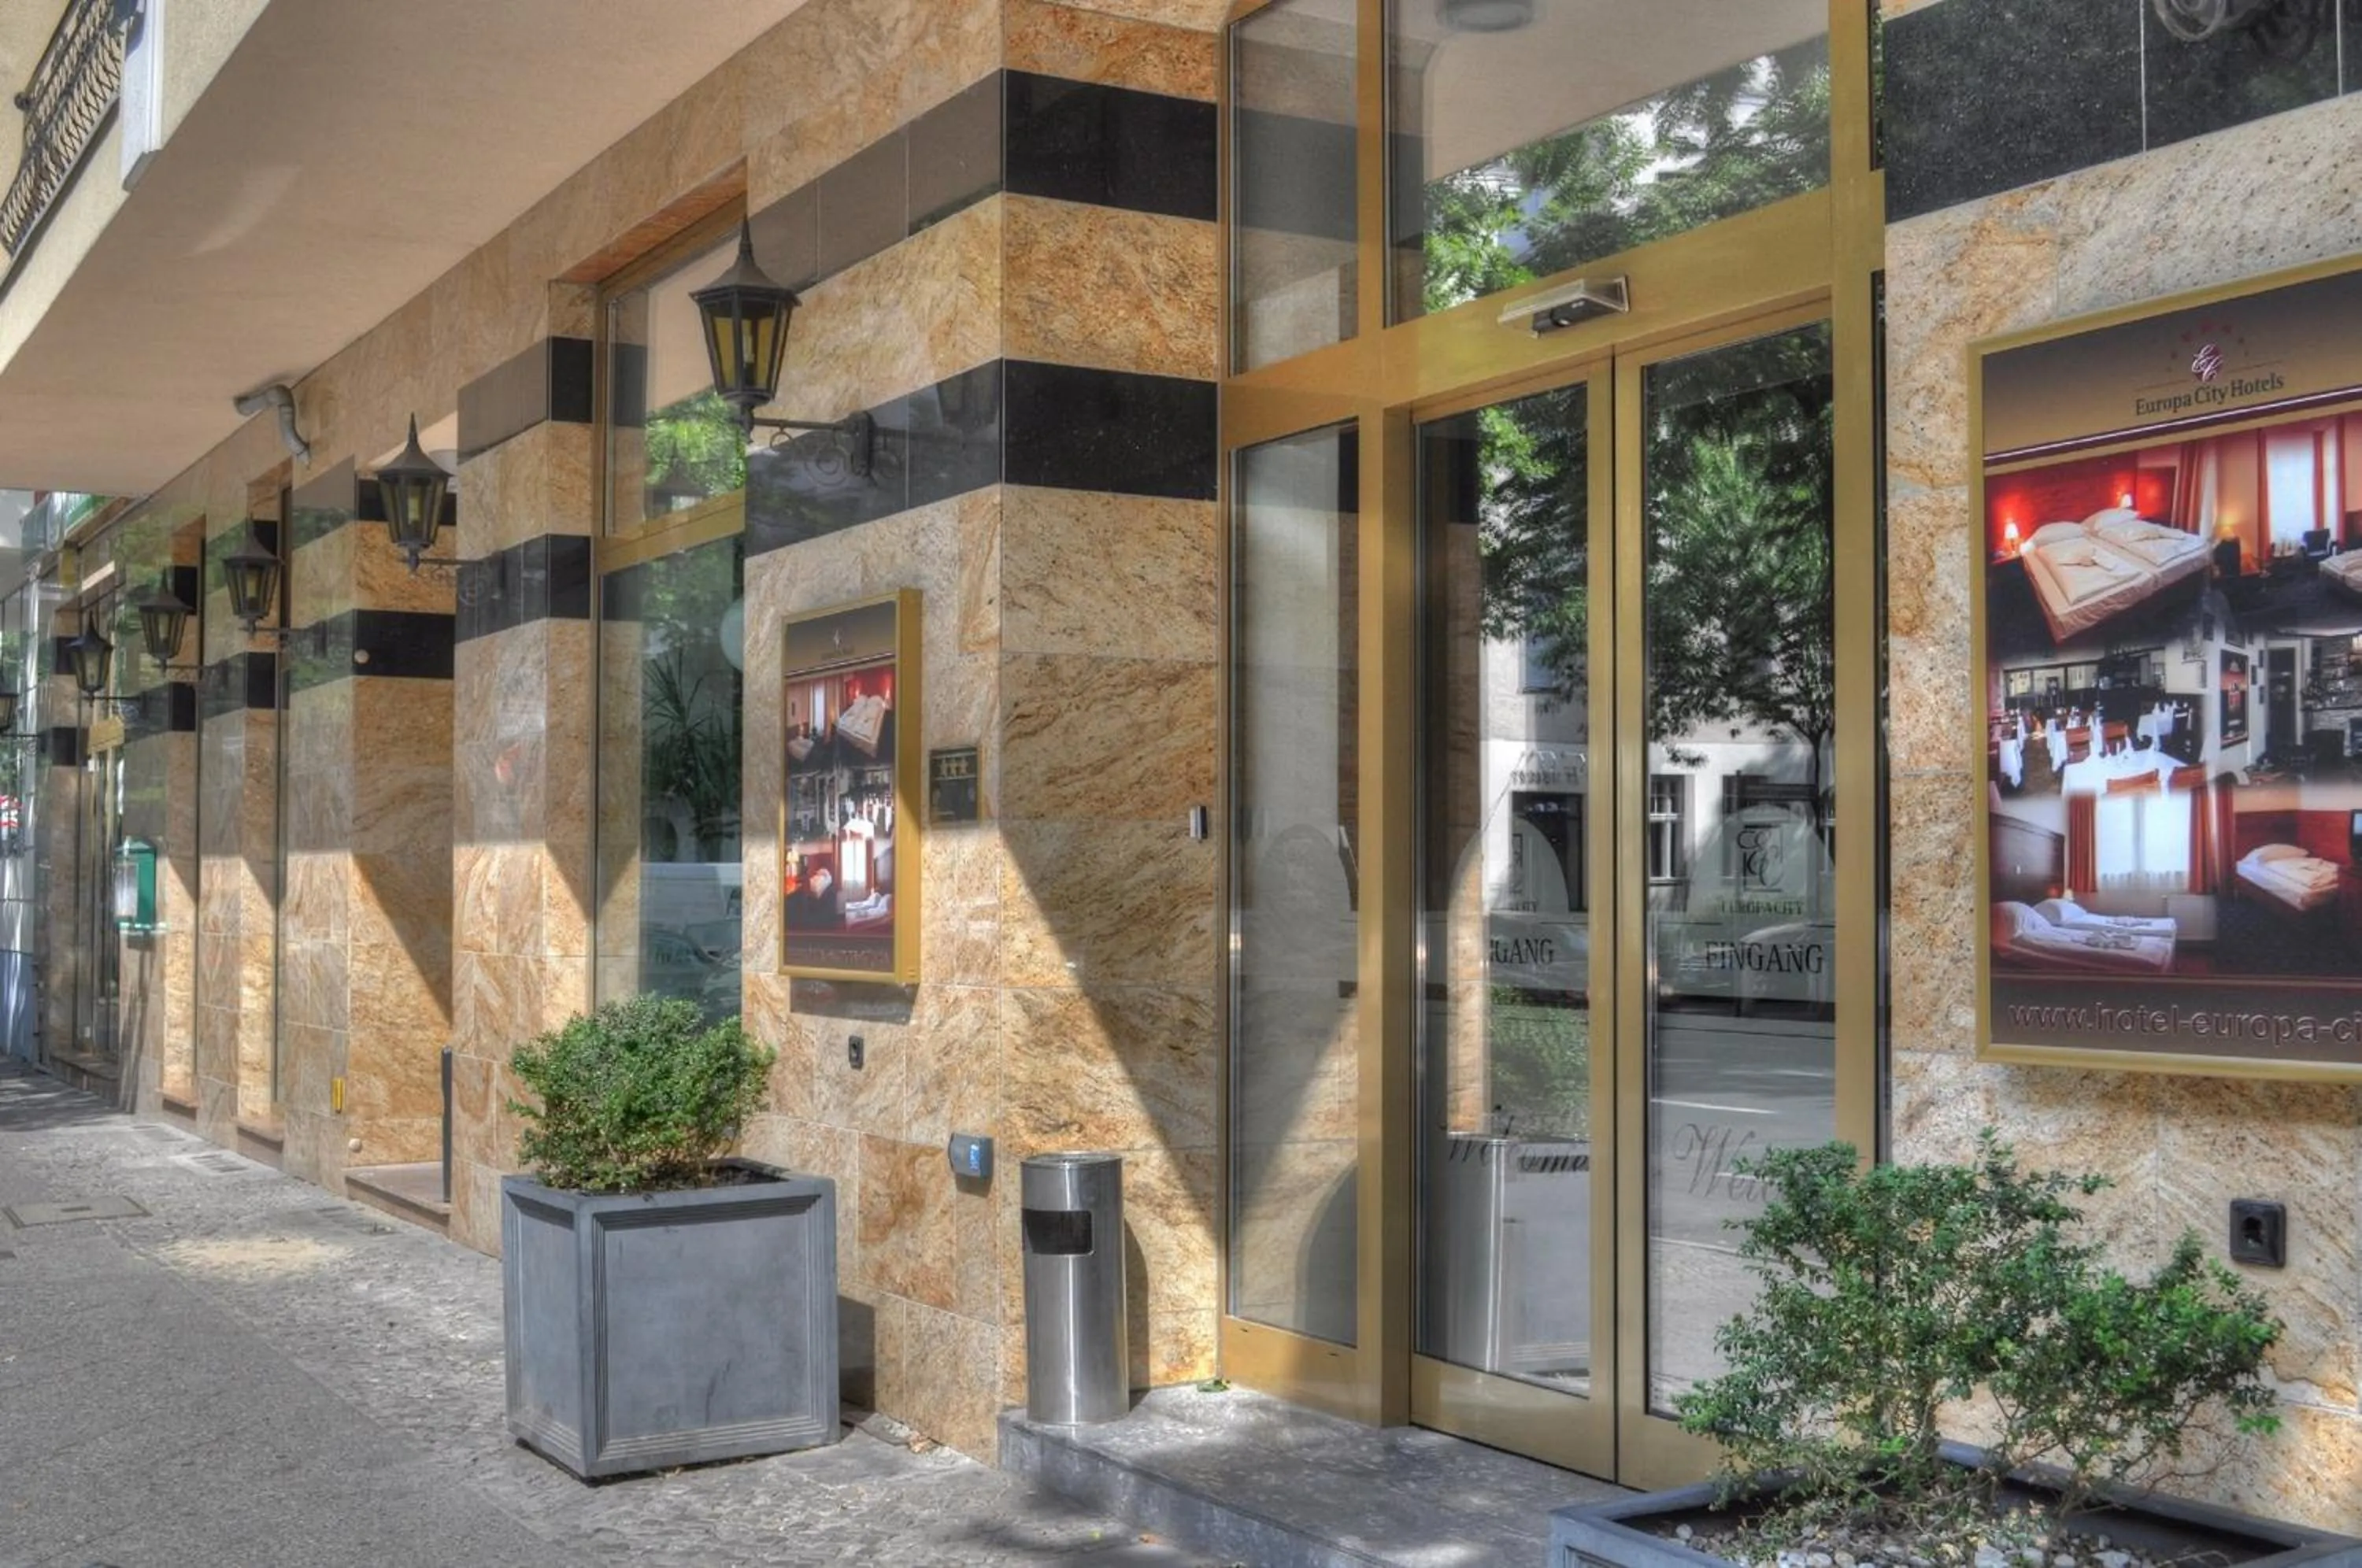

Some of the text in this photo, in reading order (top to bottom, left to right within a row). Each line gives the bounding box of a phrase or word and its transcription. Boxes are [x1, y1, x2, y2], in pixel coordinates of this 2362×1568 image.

[2136, 372, 2285, 416] Europa City Hotels
[1705, 940, 1824, 974] EINGANG
